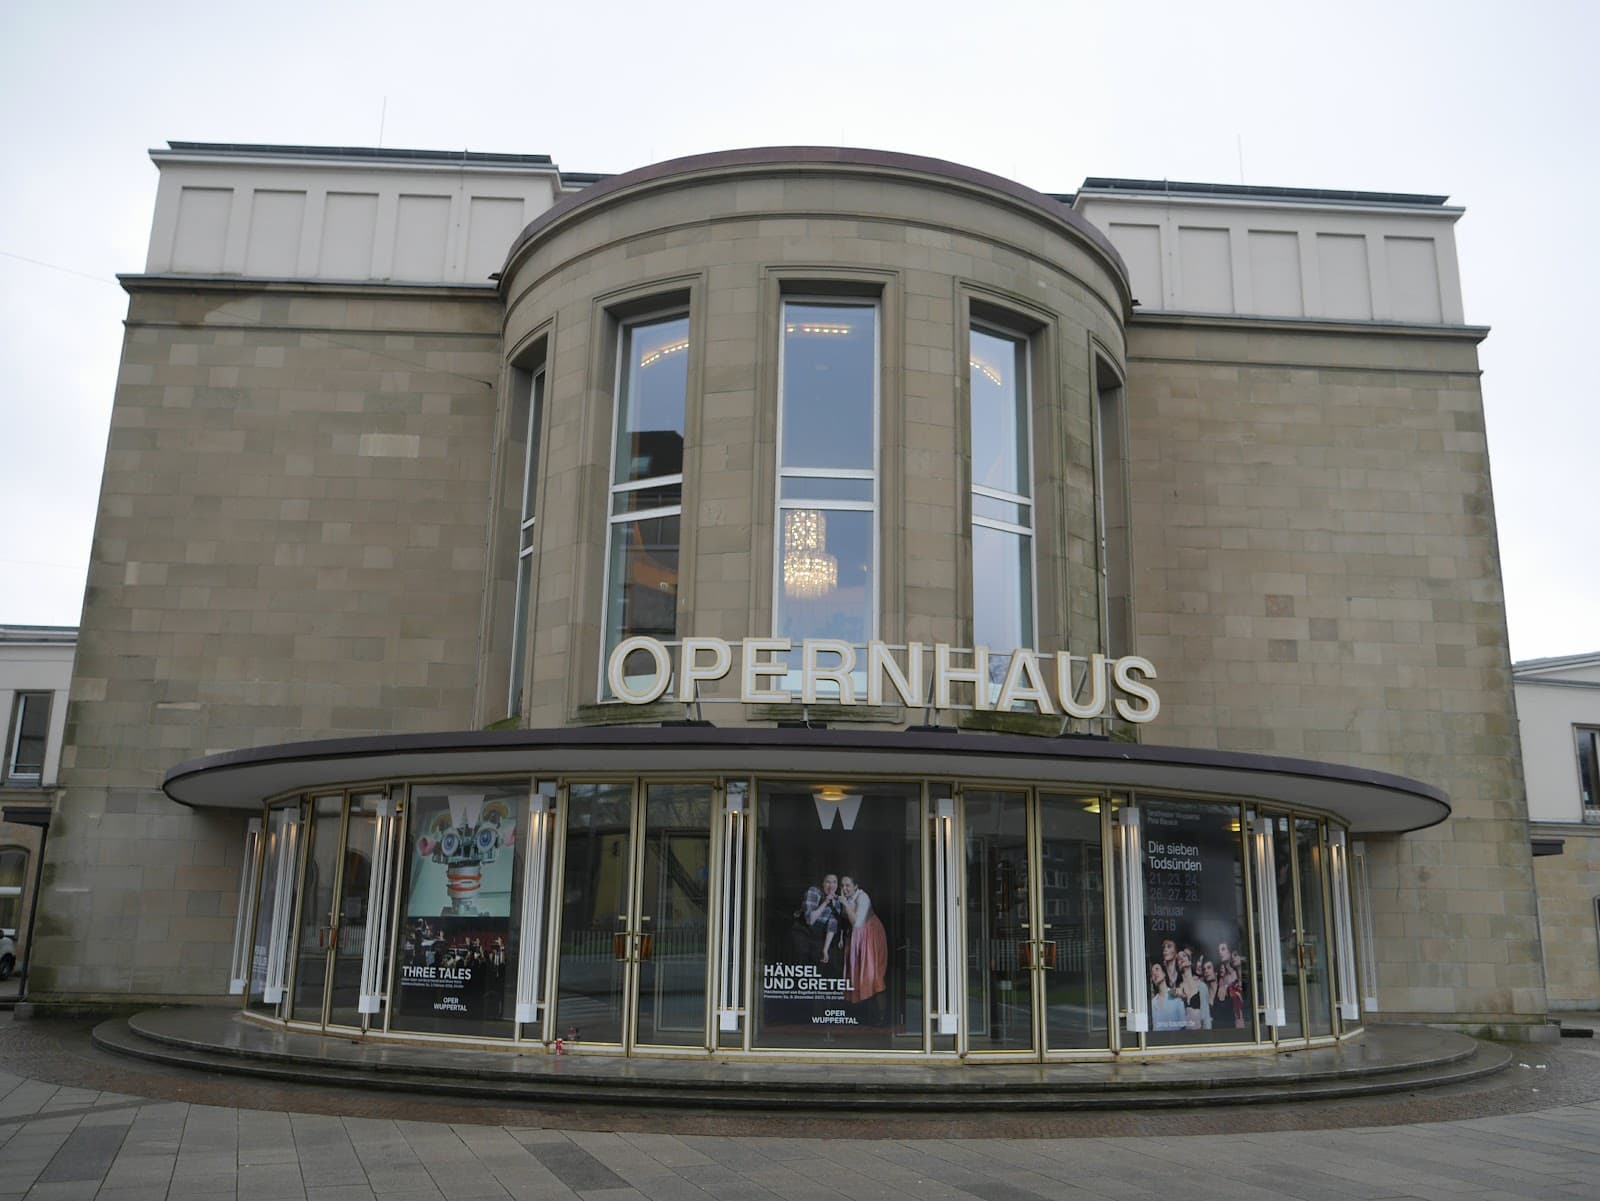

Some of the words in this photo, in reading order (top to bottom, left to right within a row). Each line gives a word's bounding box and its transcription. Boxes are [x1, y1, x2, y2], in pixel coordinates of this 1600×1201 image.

[607, 635, 1160, 722] OPERNHAUS
[813, 794, 864, 830] W
[1148, 841, 1165, 854] Die
[1167, 843, 1199, 856] sieben
[1149, 856, 1202, 871] Todsünden
[1151, 903, 1185, 917] Januar
[403, 966, 436, 977] THREE
[438, 967, 472, 980] TALES
[764, 963, 821, 977] HÄNSEL
[764, 977, 794, 990] UND
[797, 978, 855, 991] GRETEL
[433, 1003, 467, 1011] WUPPERTAL
